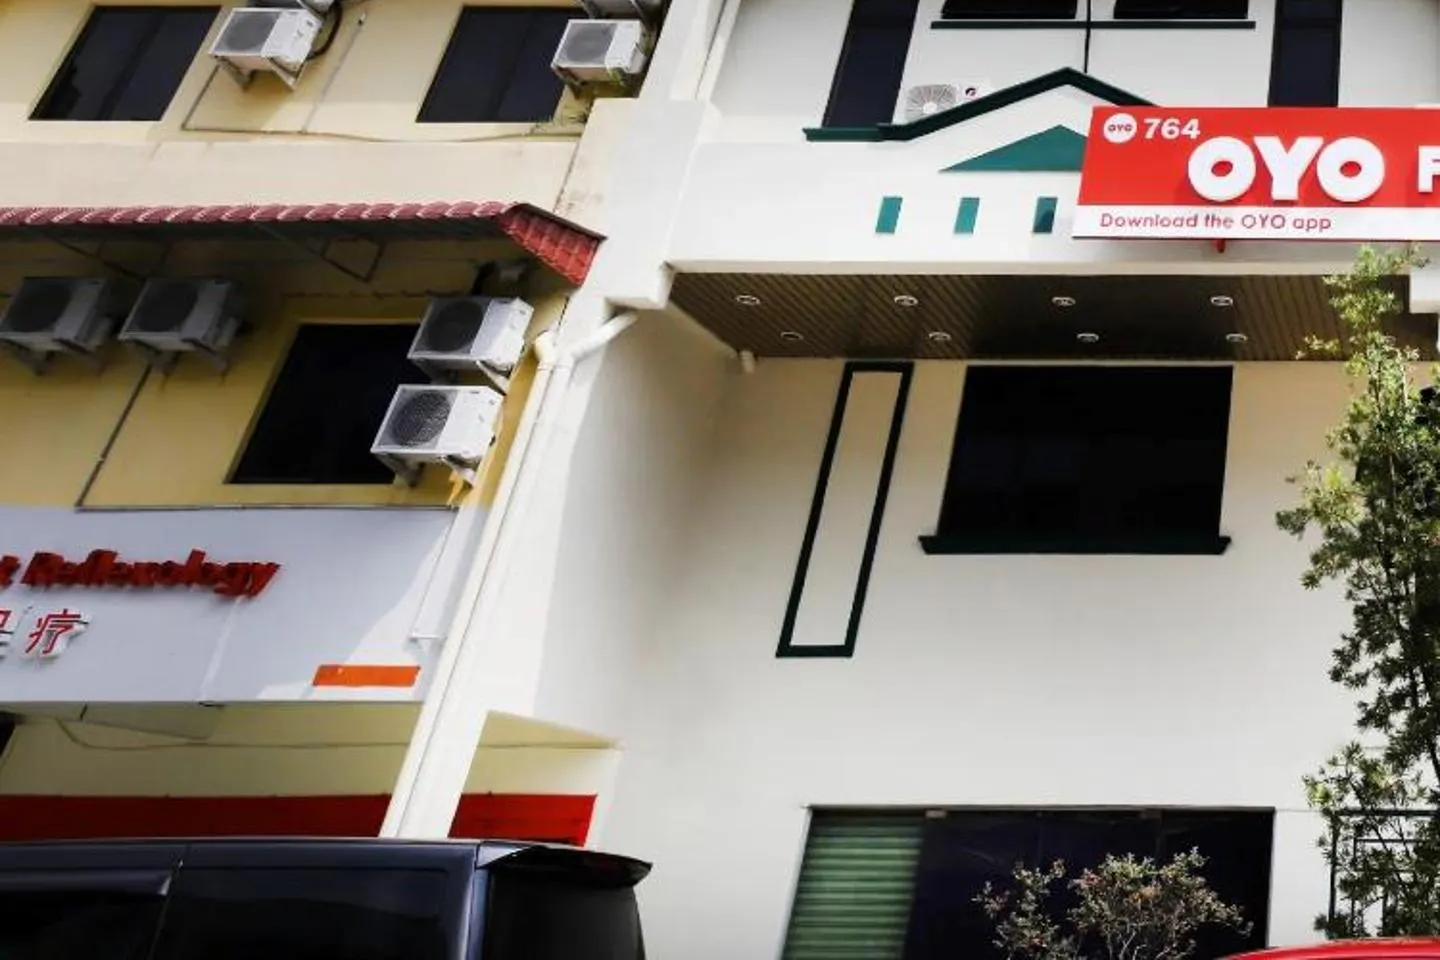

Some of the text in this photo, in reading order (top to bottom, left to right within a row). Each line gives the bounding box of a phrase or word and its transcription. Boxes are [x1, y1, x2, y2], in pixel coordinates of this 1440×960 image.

[1143, 118, 1201, 139] 764
[1188, 136, 1386, 203] OYO
[1100, 213, 1332, 232] Download the OYO app
